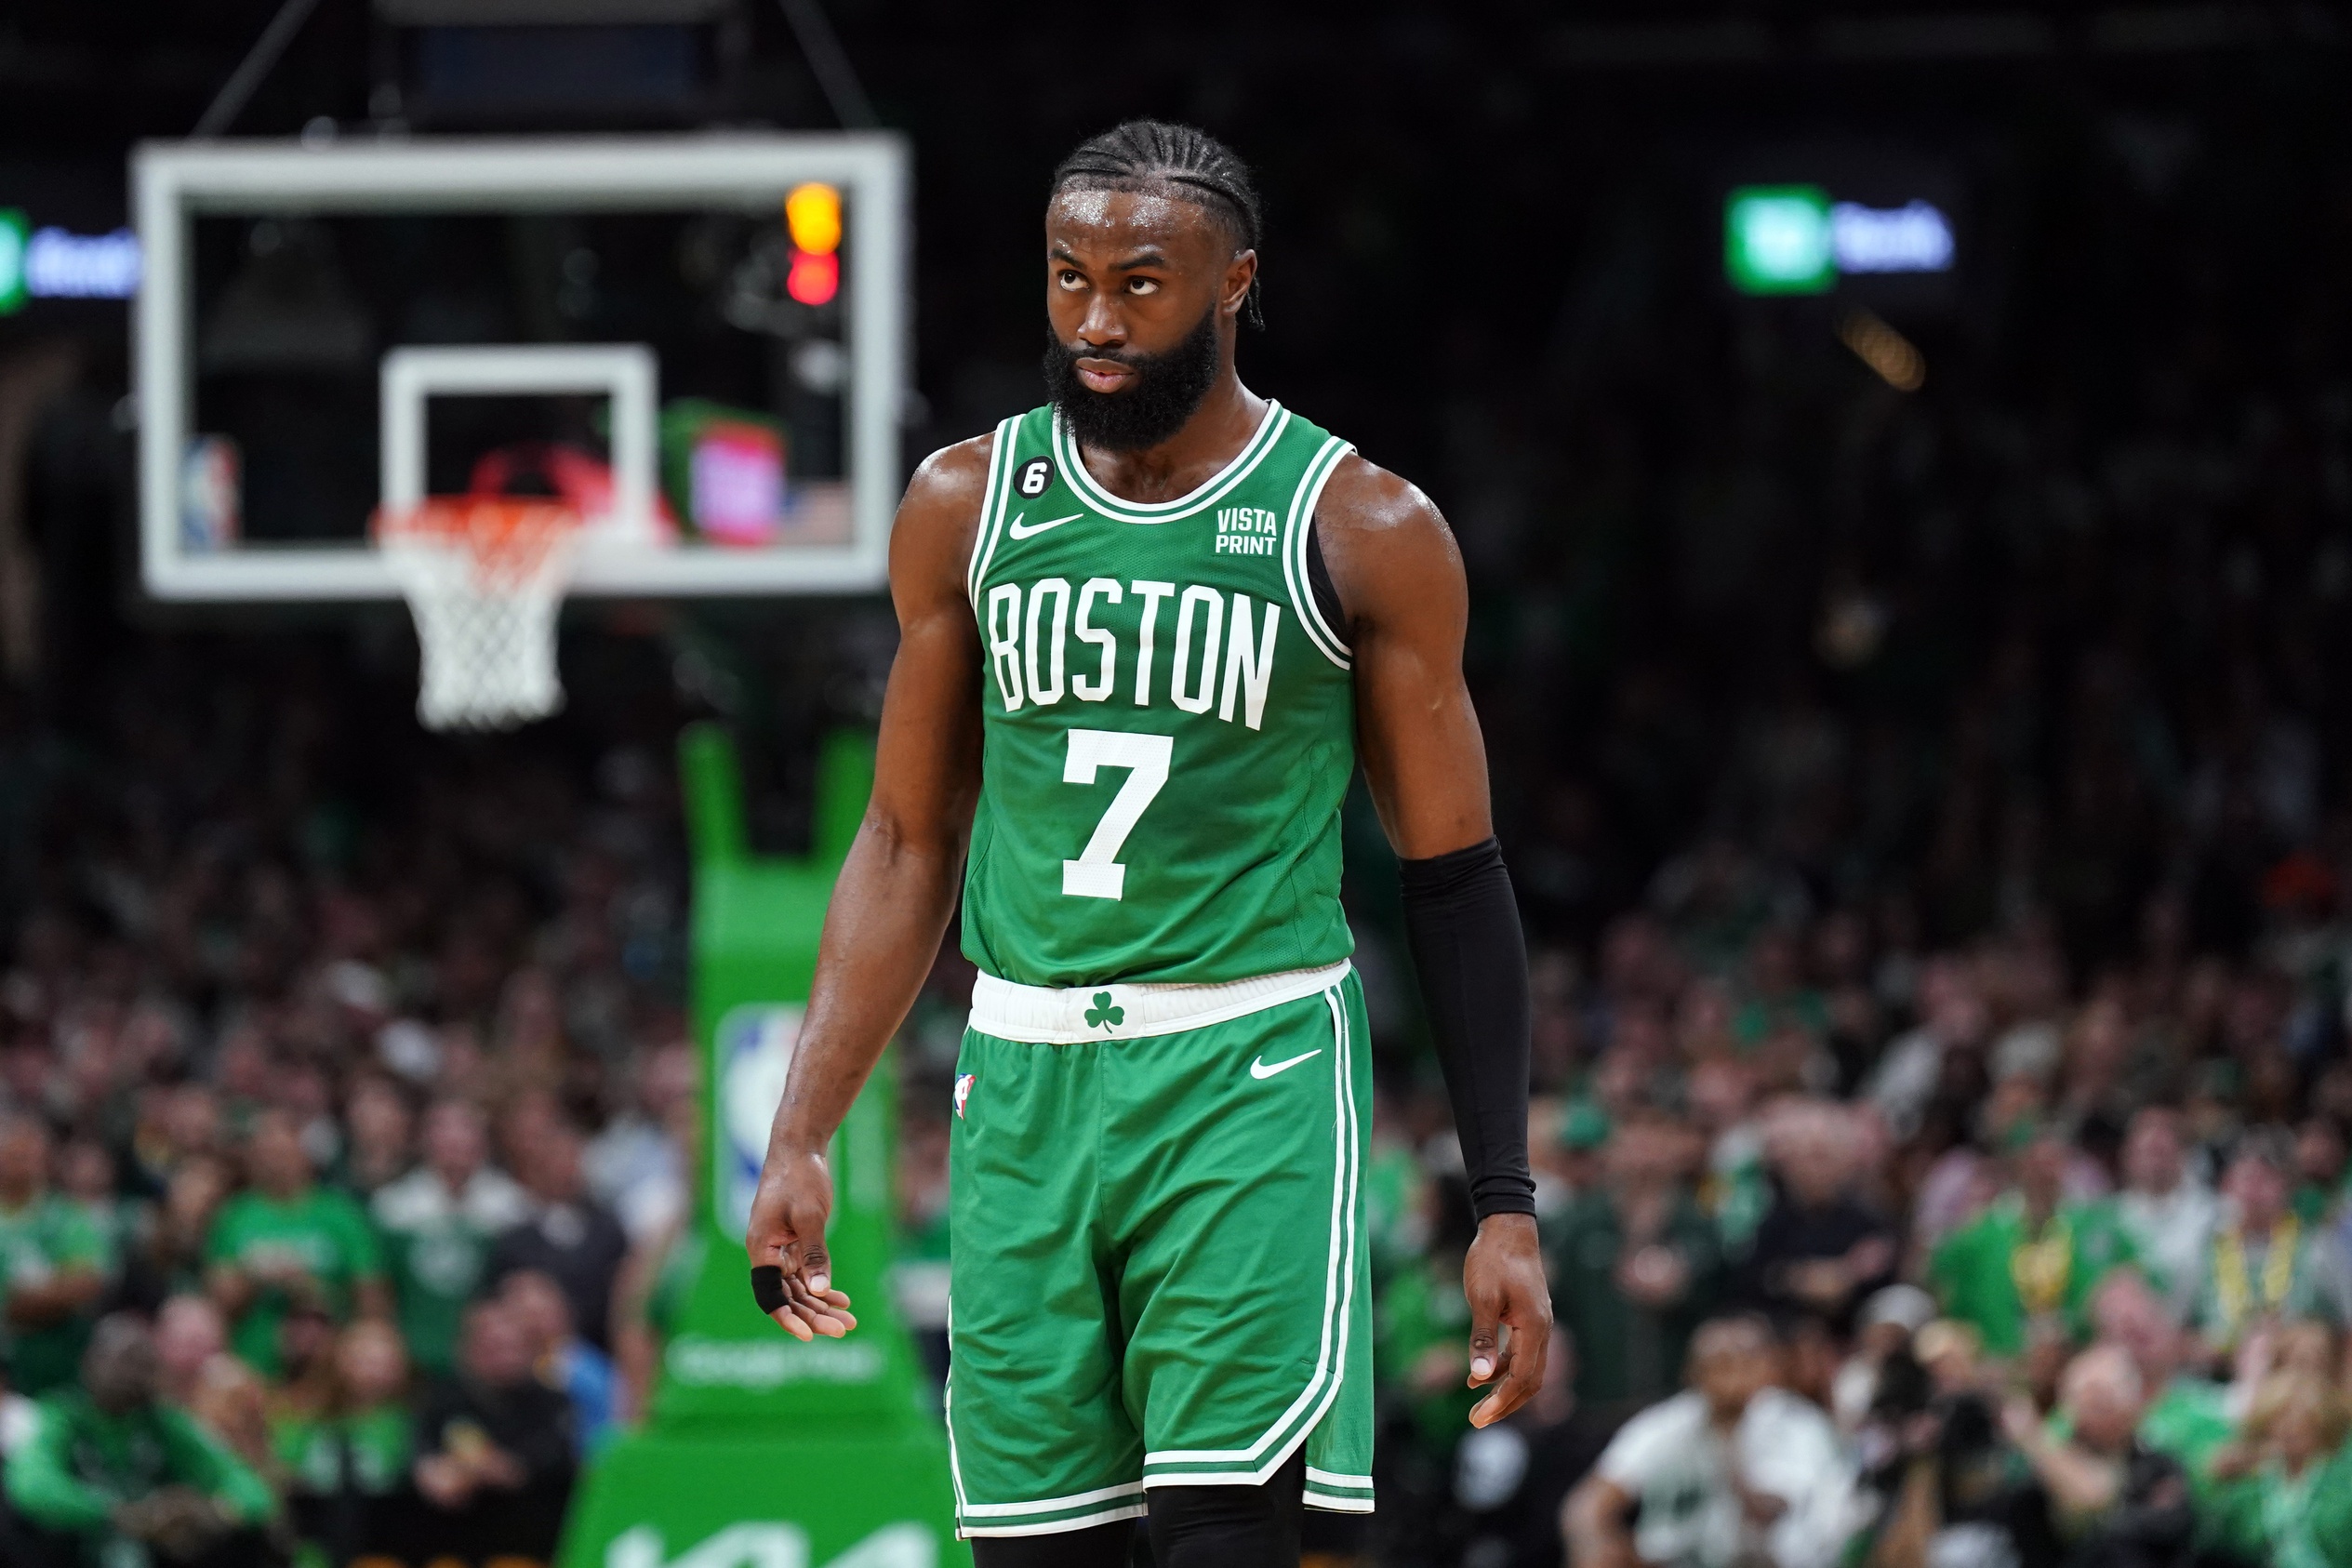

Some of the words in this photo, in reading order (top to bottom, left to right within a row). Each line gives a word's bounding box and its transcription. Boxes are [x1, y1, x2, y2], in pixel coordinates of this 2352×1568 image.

[1022, 461, 1048, 494] 6
[1216, 507, 1278, 537] VISTA
[1215, 534, 1277, 556] PRINT
[988, 577, 1281, 731] BOSTON
[1061, 728, 1175, 901] 7
